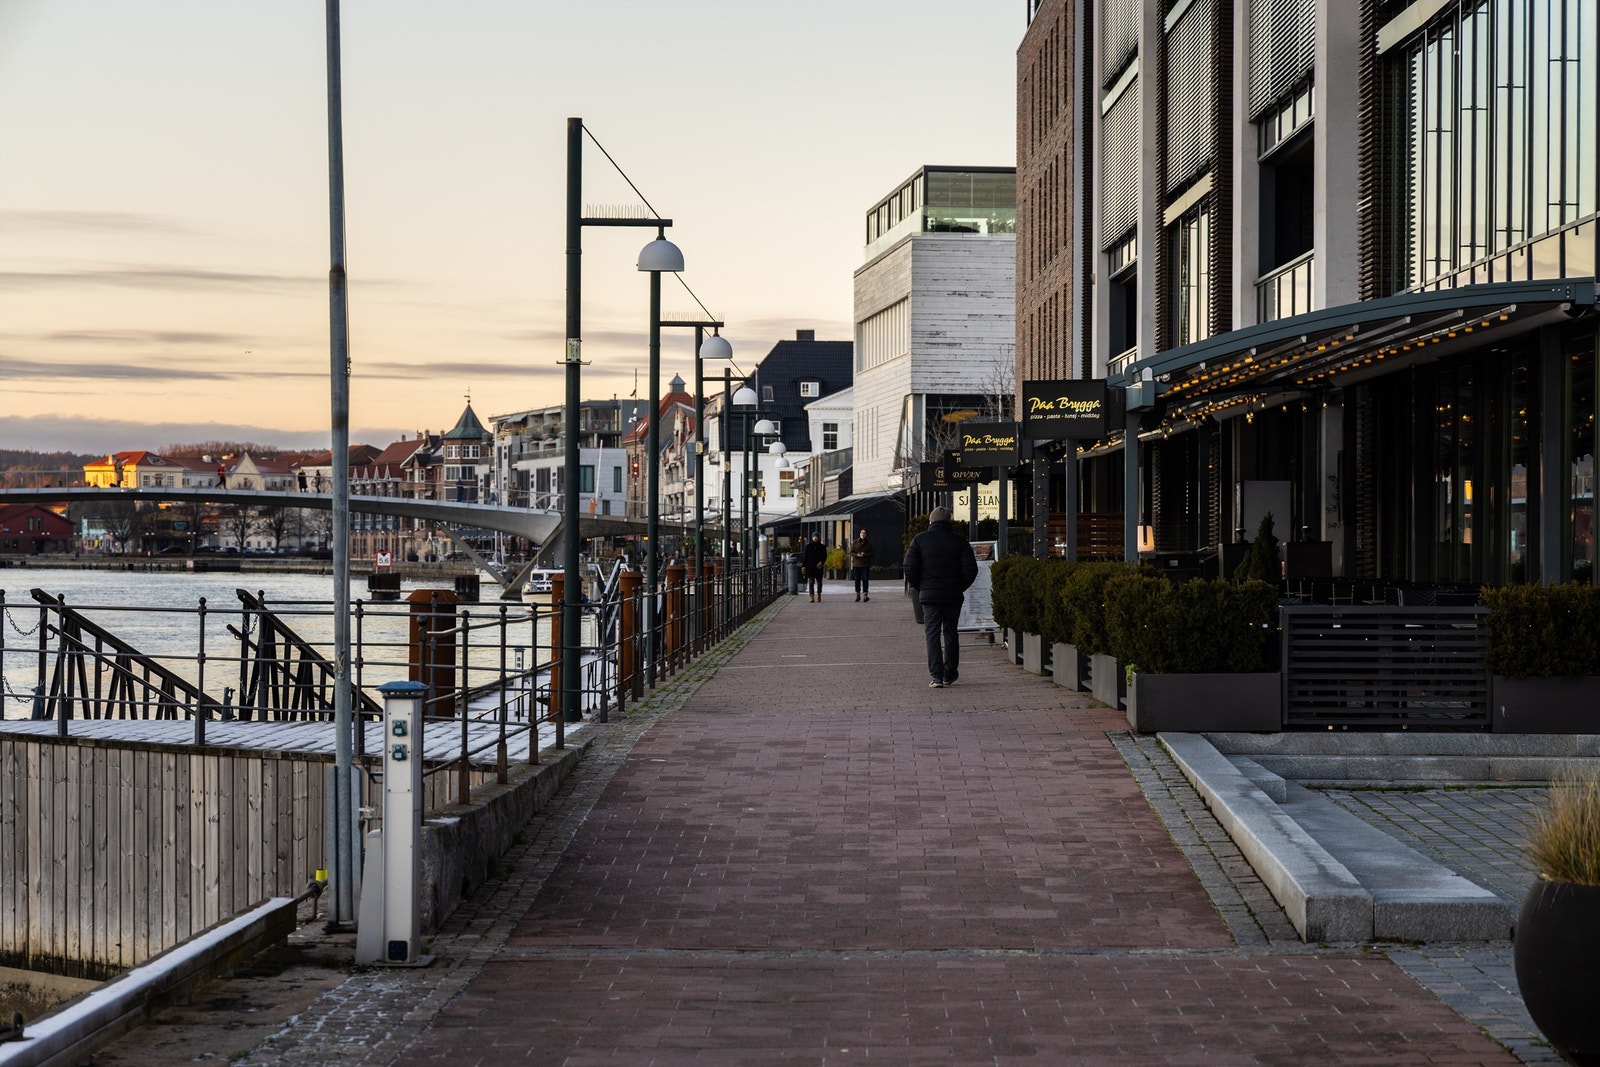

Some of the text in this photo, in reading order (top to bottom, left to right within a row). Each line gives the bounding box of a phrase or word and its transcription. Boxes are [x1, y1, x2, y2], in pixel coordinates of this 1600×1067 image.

[1028, 396, 1101, 412] Paa Brygga
[963, 434, 1014, 446] Paa Brygga
[952, 470, 982, 479] DIVAN
